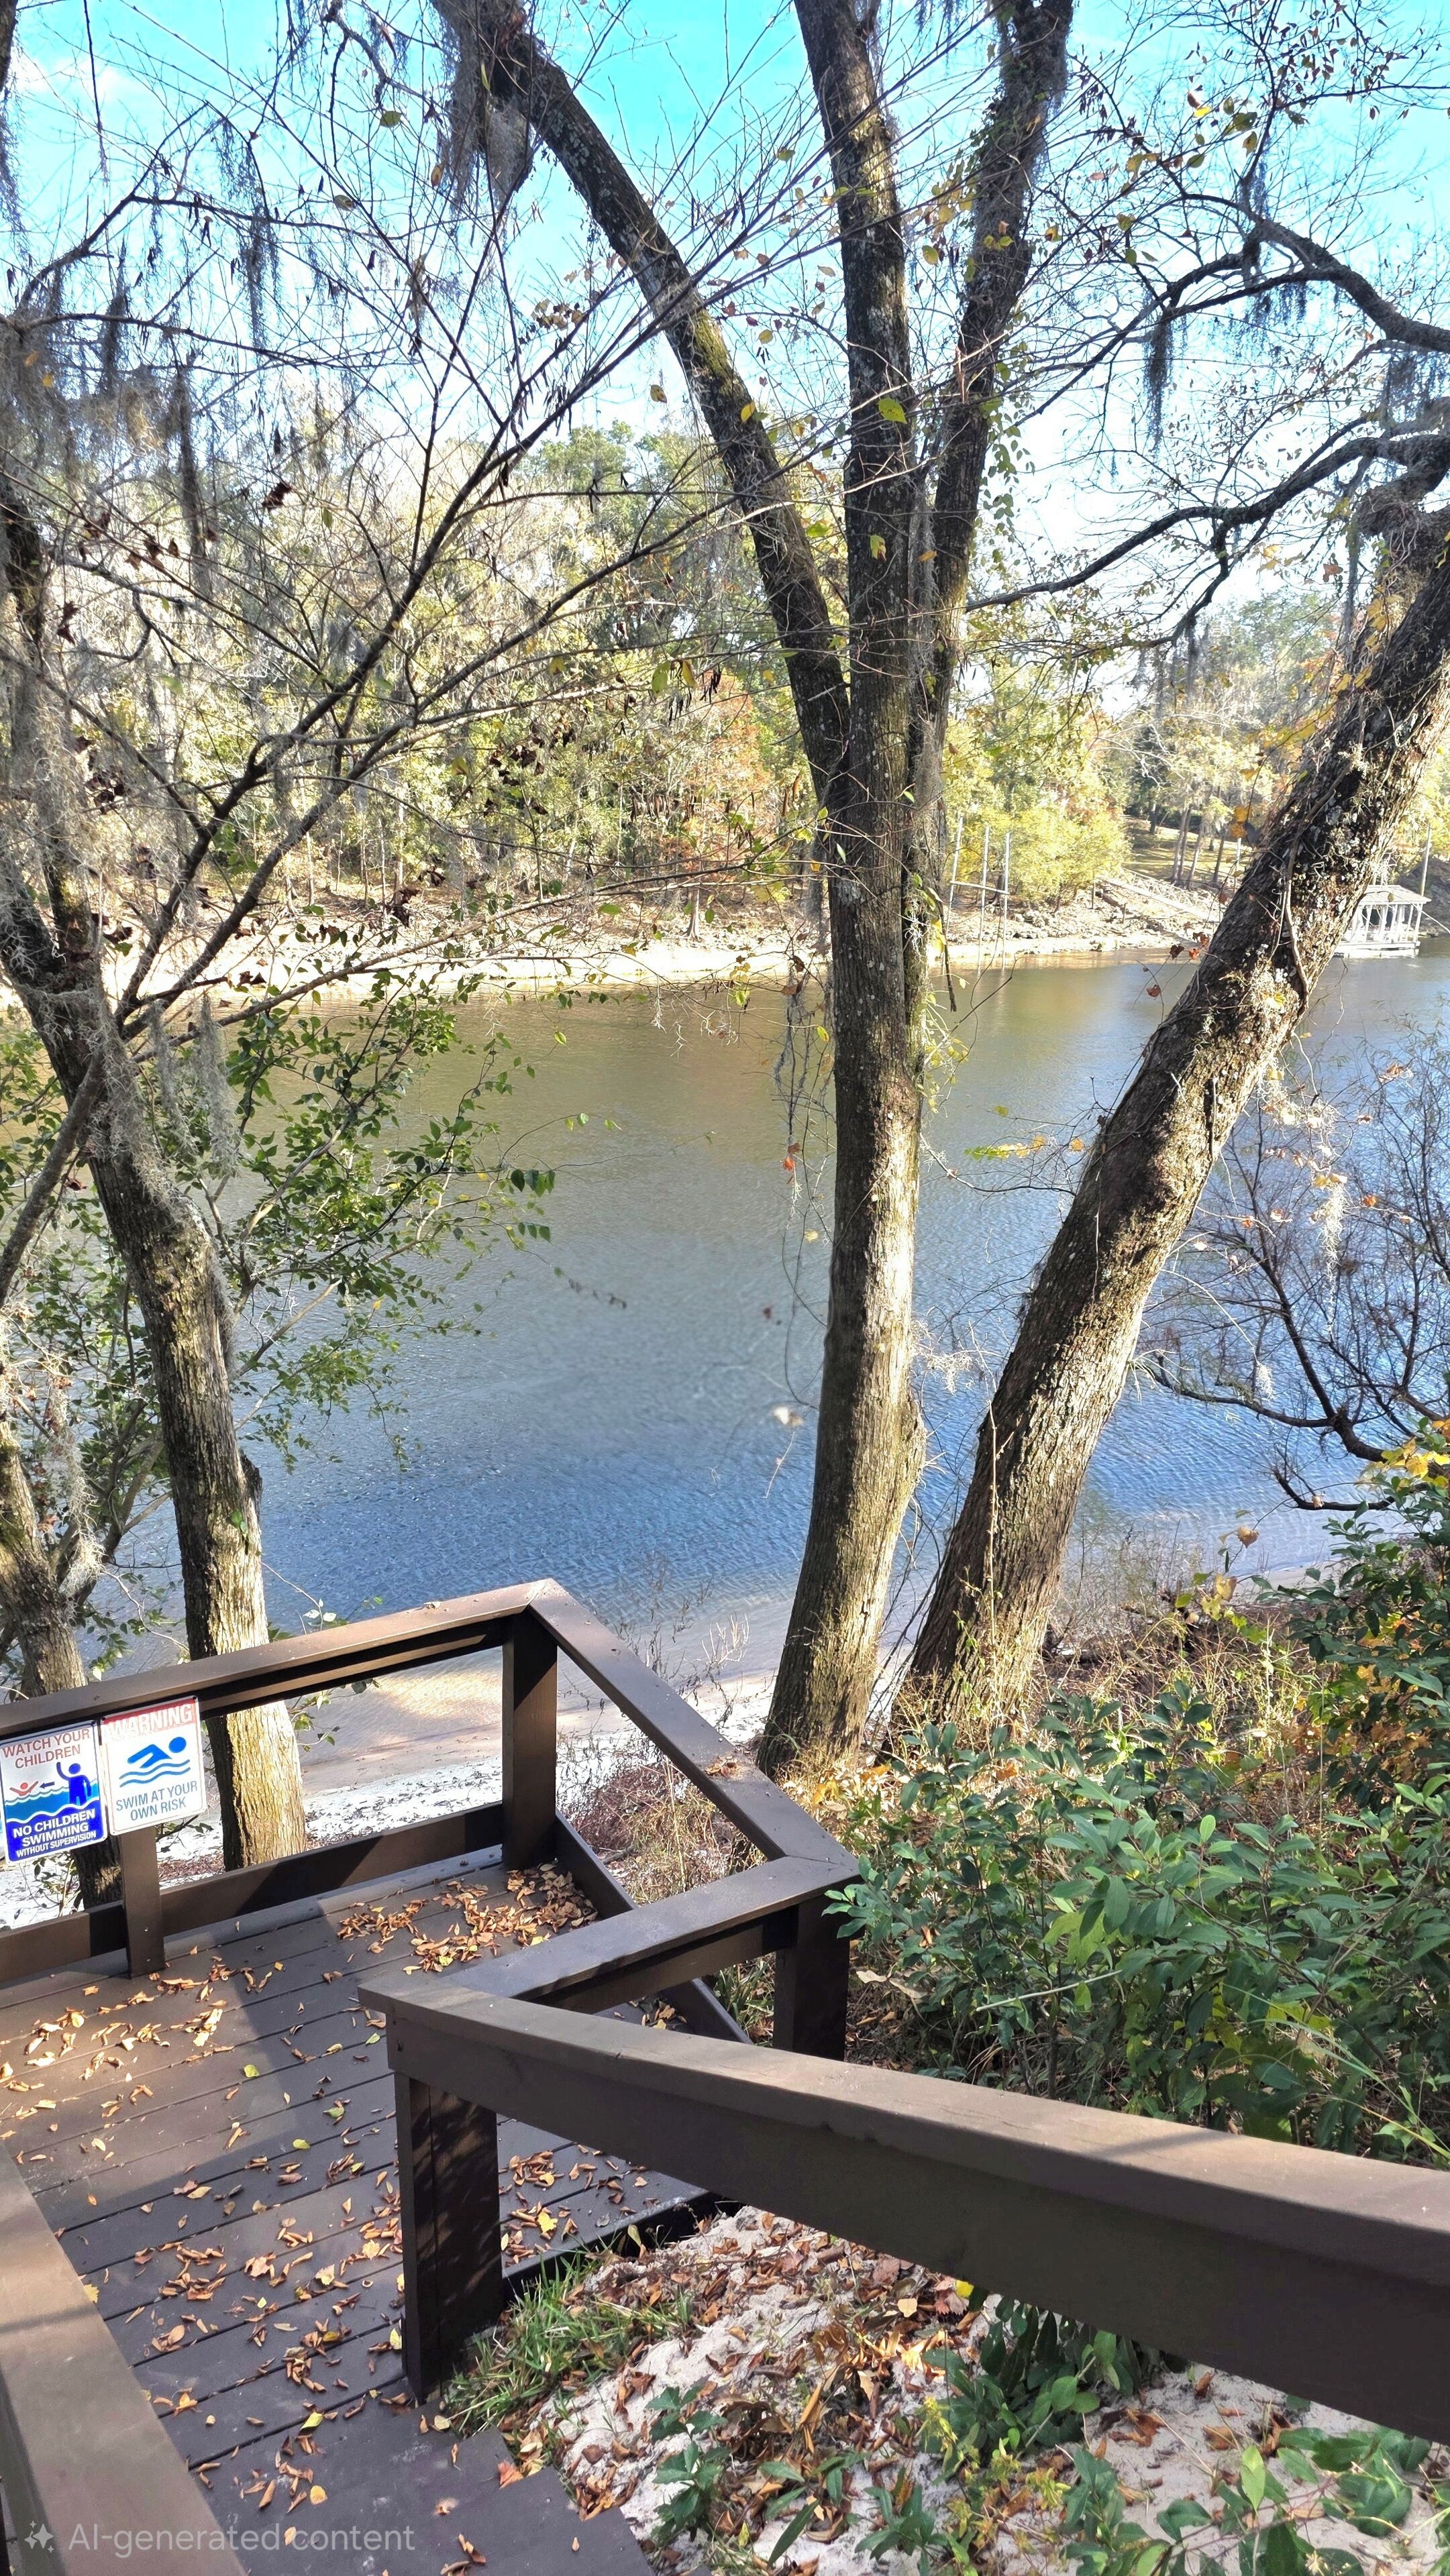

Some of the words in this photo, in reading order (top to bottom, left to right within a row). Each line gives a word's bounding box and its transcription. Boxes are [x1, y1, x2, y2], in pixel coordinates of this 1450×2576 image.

[3, 1737, 51, 1758] WATCH
[54, 1729, 90, 1745] YOUR
[15, 1744, 81, 1769] CHILDREN
[116, 1794, 148, 1811] SWIM
[152, 1789, 164, 1802] AT
[166, 1780, 198, 1799] YOUR
[130, 1805, 158, 1821] OWN
[161, 1796, 187, 1813] RISK
[13, 1825, 32, 1838] NO
[34, 1808, 96, 1832] CHILDREN
[22, 1822, 89, 1847] SWIMMING
[16, 1842, 51, 1858] WITHOUT
[50, 1831, 97, 1849] SUPERVISION
